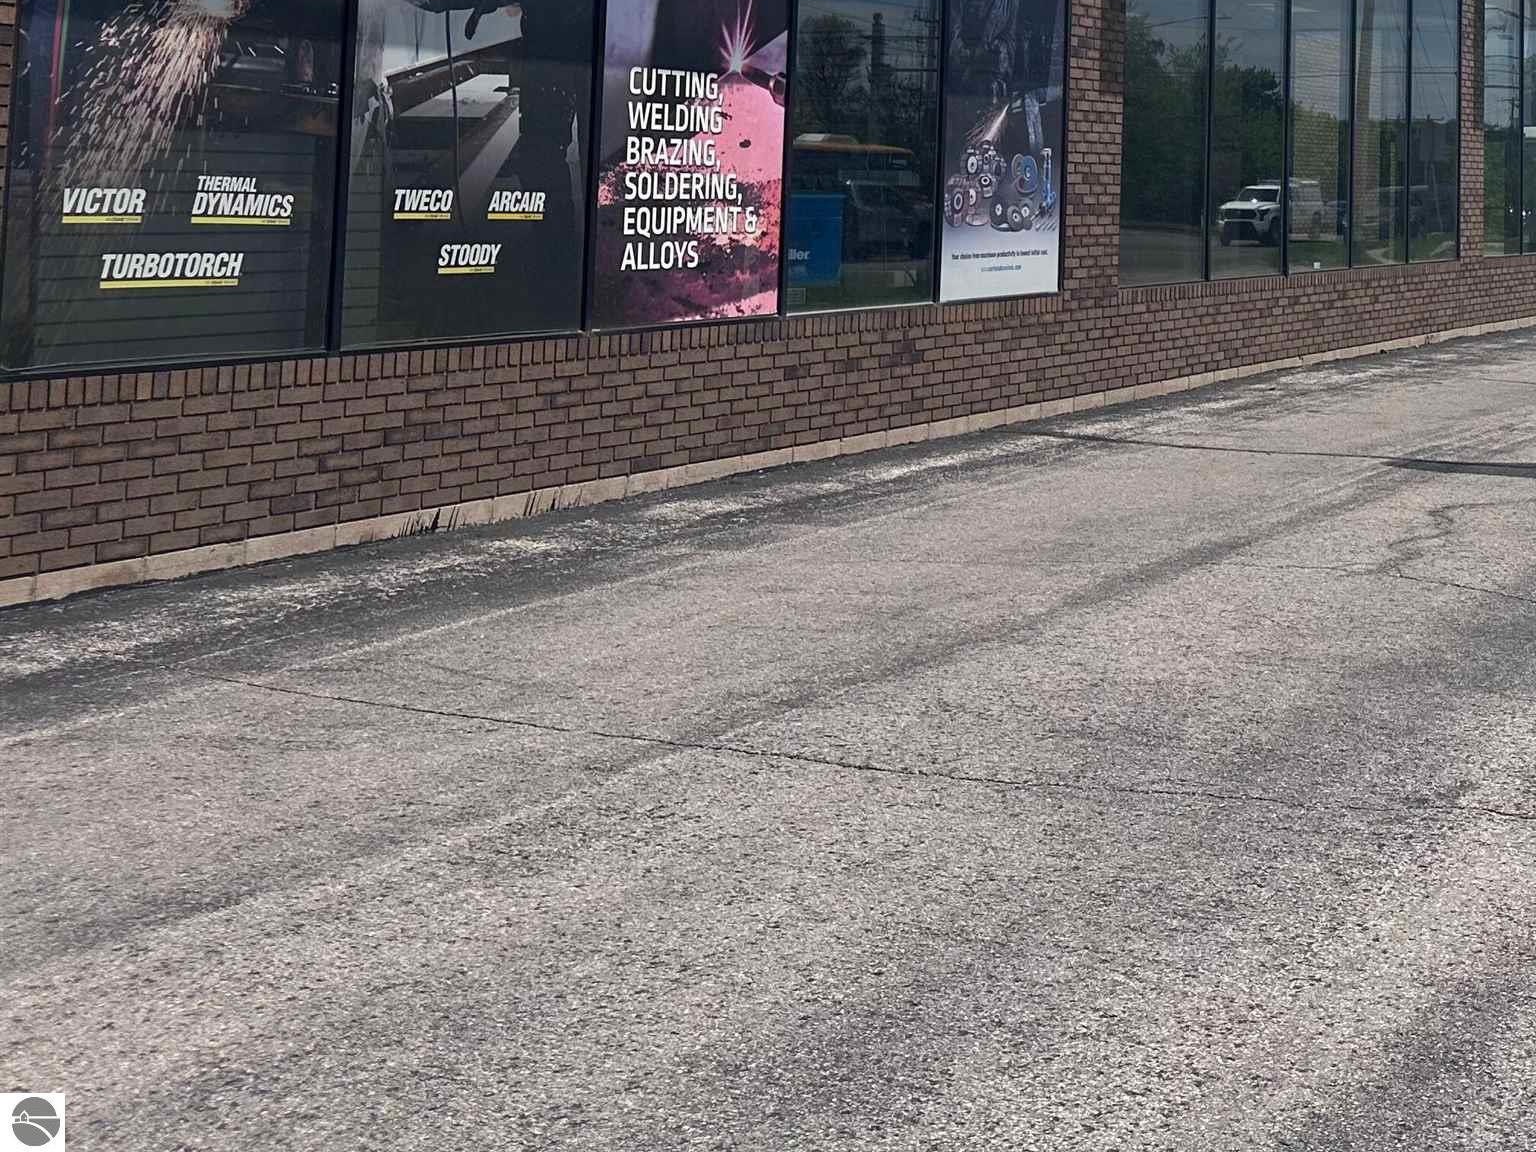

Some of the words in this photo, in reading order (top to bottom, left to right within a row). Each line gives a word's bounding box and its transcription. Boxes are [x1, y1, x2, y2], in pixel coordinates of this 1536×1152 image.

[629, 66, 723, 103] CUTTING,
[626, 136, 721, 170] BRAZING,
[197, 175, 257, 193] THERMAL
[624, 172, 743, 205] SOLDERING,
[62, 188, 146, 214] VICTOR
[191, 192, 294, 217] DYNAMICS
[393, 189, 454, 211] TWECO
[488, 191, 546, 212] ARCAIR
[623, 206, 743, 238] EQUIPMENT
[744, 206, 757, 233] &
[100, 253, 244, 279] TURBOTORCH
[438, 244, 502, 266] STOODY
[620, 241, 699, 271] ALLOYS
